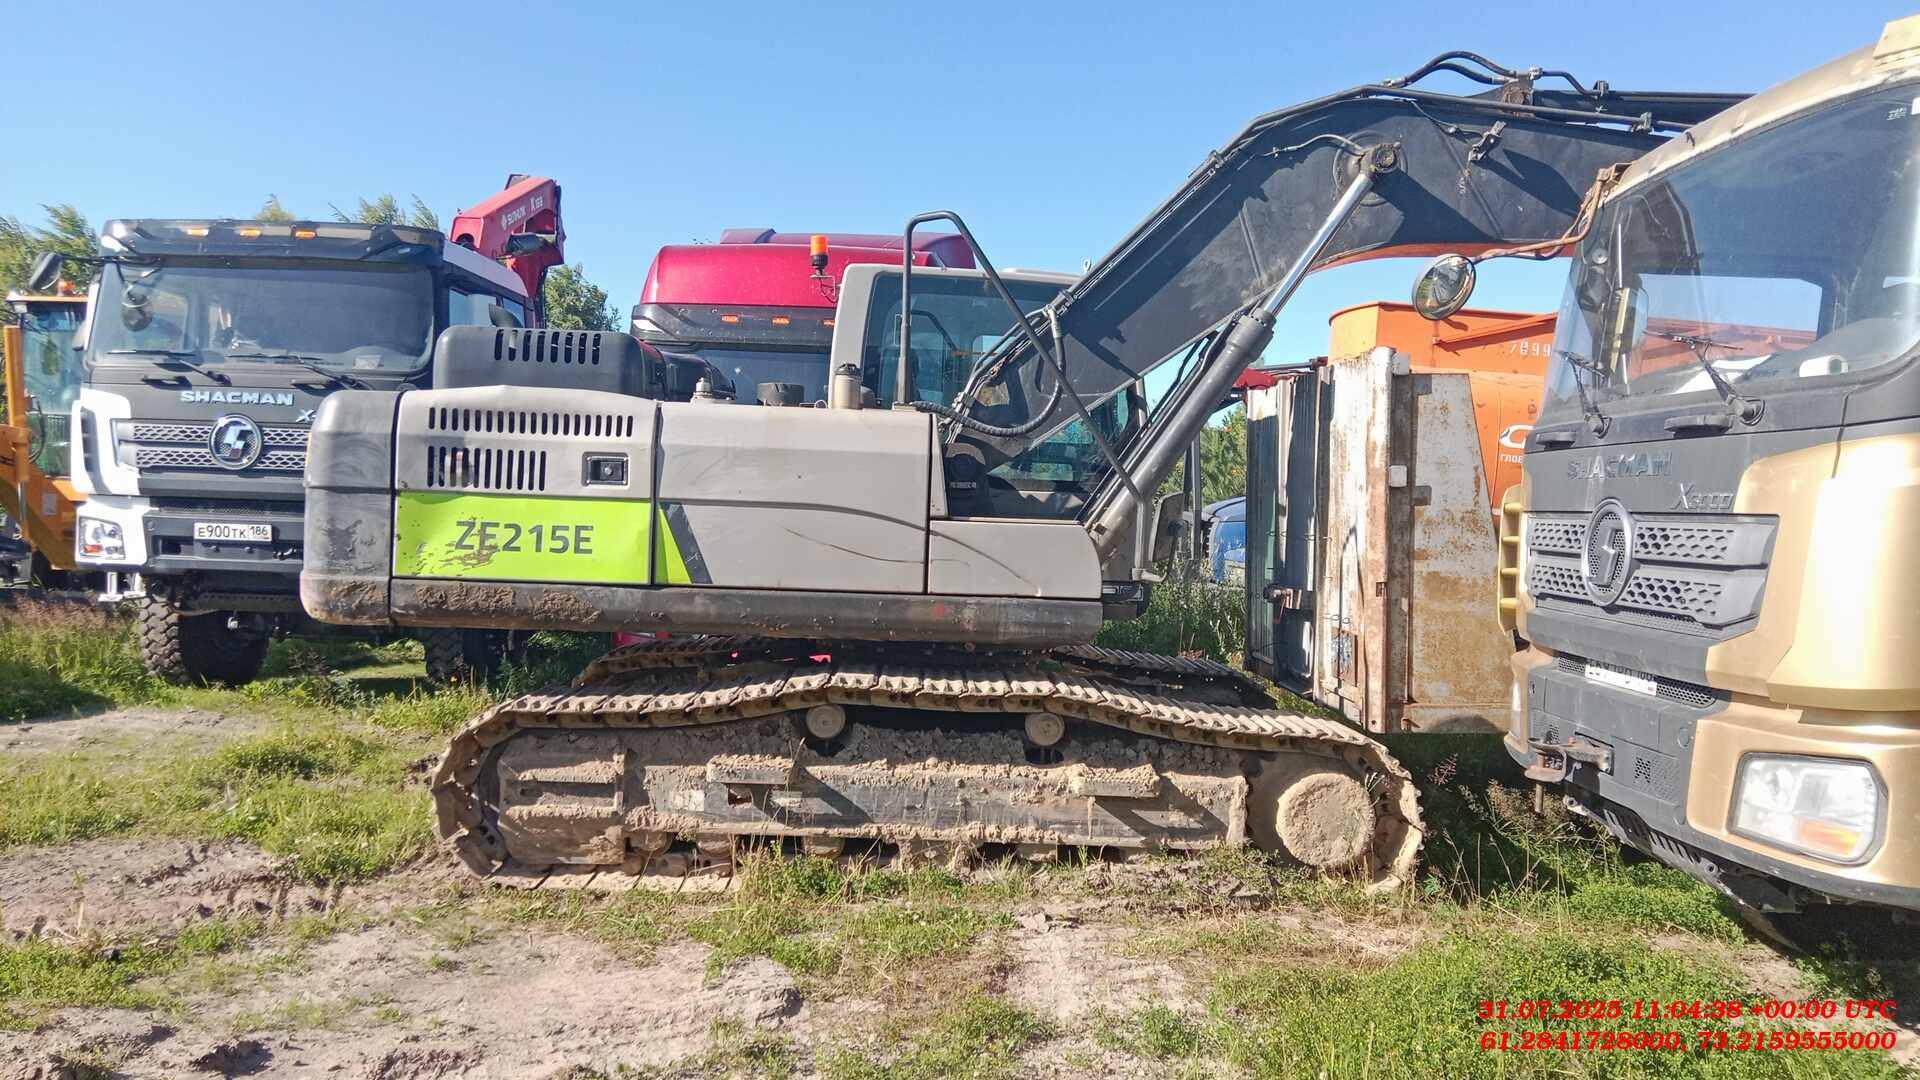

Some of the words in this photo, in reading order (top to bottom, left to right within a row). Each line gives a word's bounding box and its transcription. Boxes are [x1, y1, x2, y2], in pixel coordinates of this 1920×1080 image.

[181, 390, 294, 406] SHACMAN
[1568, 451, 1672, 479] SHACMAN
[250, 526, 268, 536] 186
[455, 520, 594, 554] ZE215E
